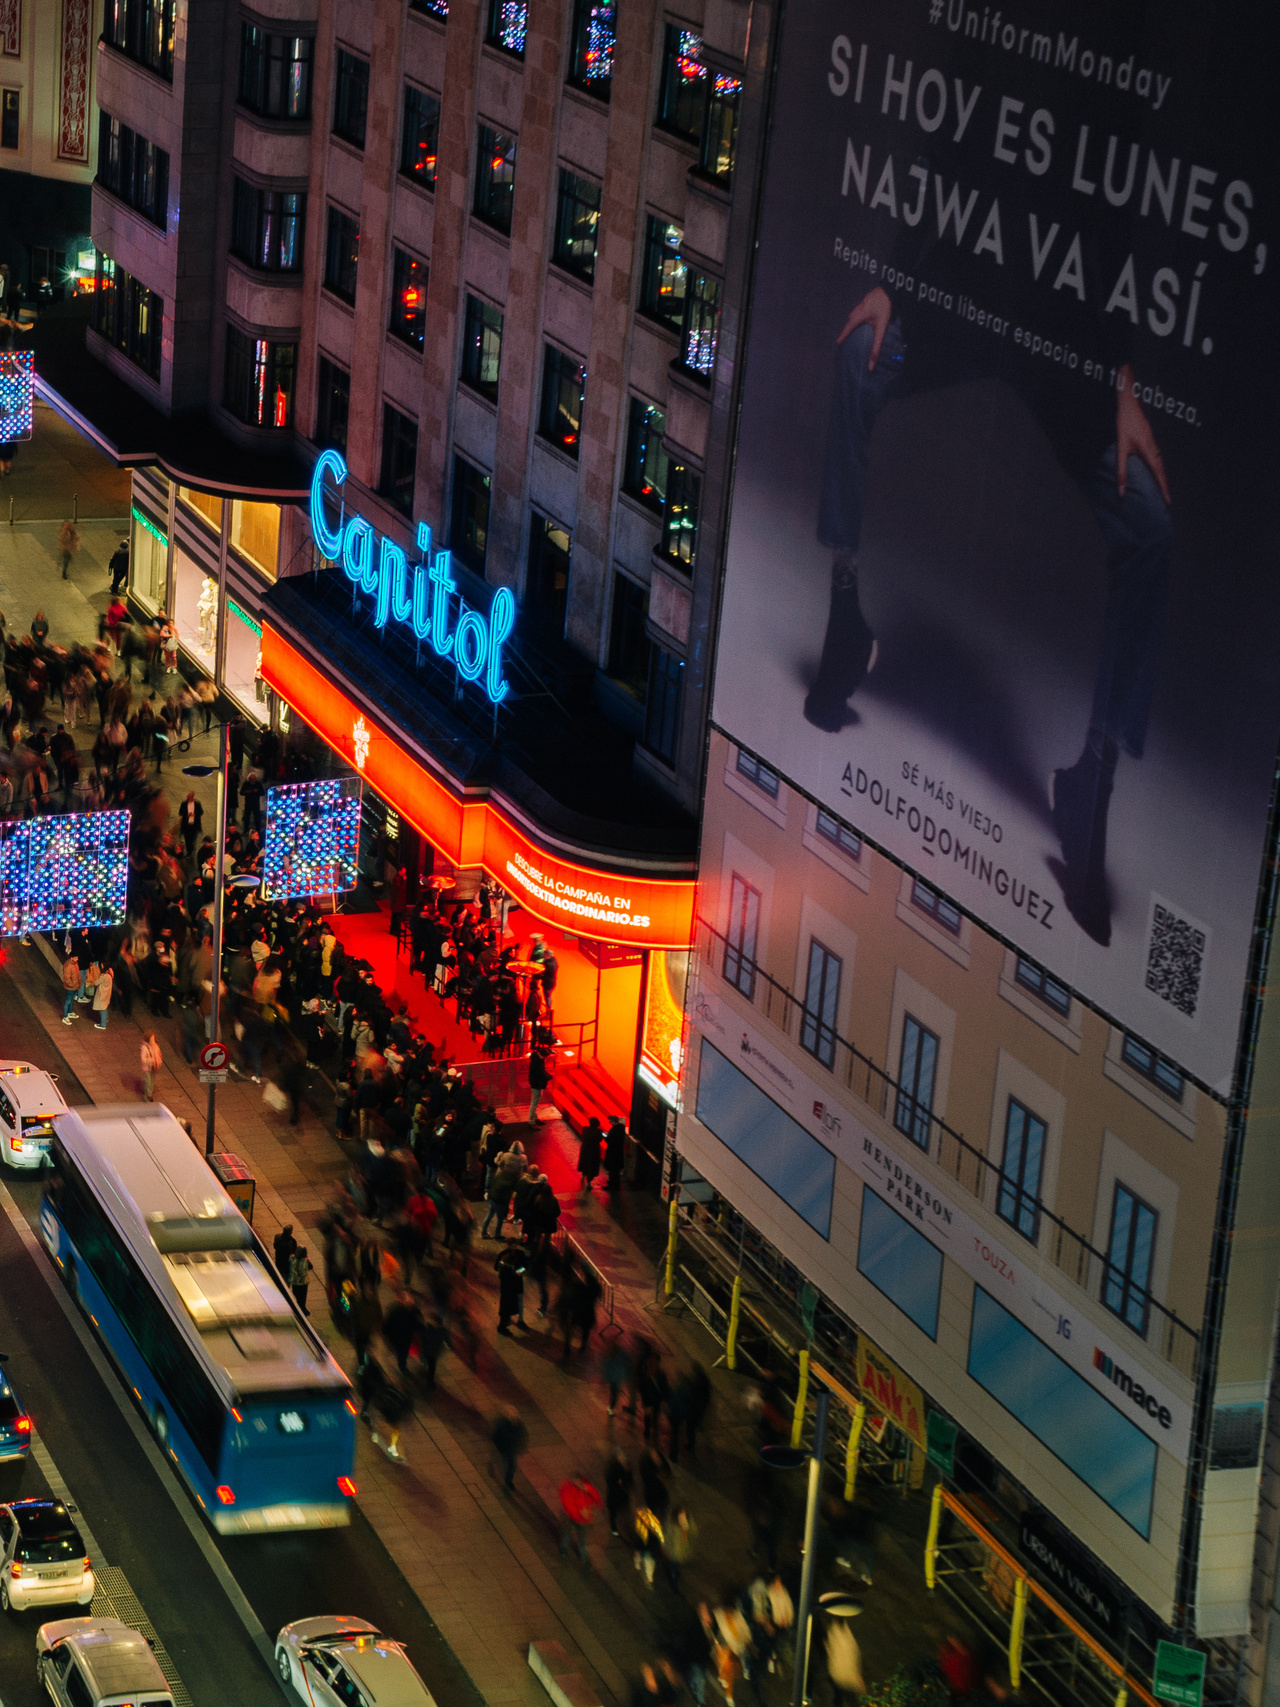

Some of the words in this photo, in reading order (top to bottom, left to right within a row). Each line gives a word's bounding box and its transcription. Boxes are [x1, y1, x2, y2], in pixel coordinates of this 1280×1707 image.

[928, 0, 1172, 110] #UniformMonday
[827, 34, 868, 104] SI
[881, 52, 982, 144] HOY
[993, 94, 1056, 177] ES
[1072, 124, 1268, 275] LUNES,
[841, 136, 1005, 266] NAJWA
[1028, 212, 1087, 301] VA
[1105, 252, 1214, 356] ASÍ.
[833, 237, 878, 277] Repite
[881, 261, 914, 292] ropa
[918, 279, 953, 311] para
[957, 297, 1009, 337] liberar
[1013, 323, 1079, 371] espacio
[1083, 355, 1104, 381] en
[1108, 366, 1126, 392] tu
[1130, 376, 1202, 427] cabeza.
[310, 449, 516, 703] Capitol
[901, 760, 920, 787] SÉ
[922, 779, 955, 811] MÁS
[959, 798, 1004, 845] VIEJO
[506, 860, 651, 928] UNSORTEOEXTRAORDINARIO.ES
[514, 852, 544, 884] DESCUBRE
[544, 875, 555, 890] LA
[555, 881, 611, 907] CAMPAÑA
[613, 896, 631, 910] EN
[863, 1137, 953, 1225] HENDERSON
[886, 1178, 926, 1221] PARK
[1113, 1364, 1173, 1429] mace
